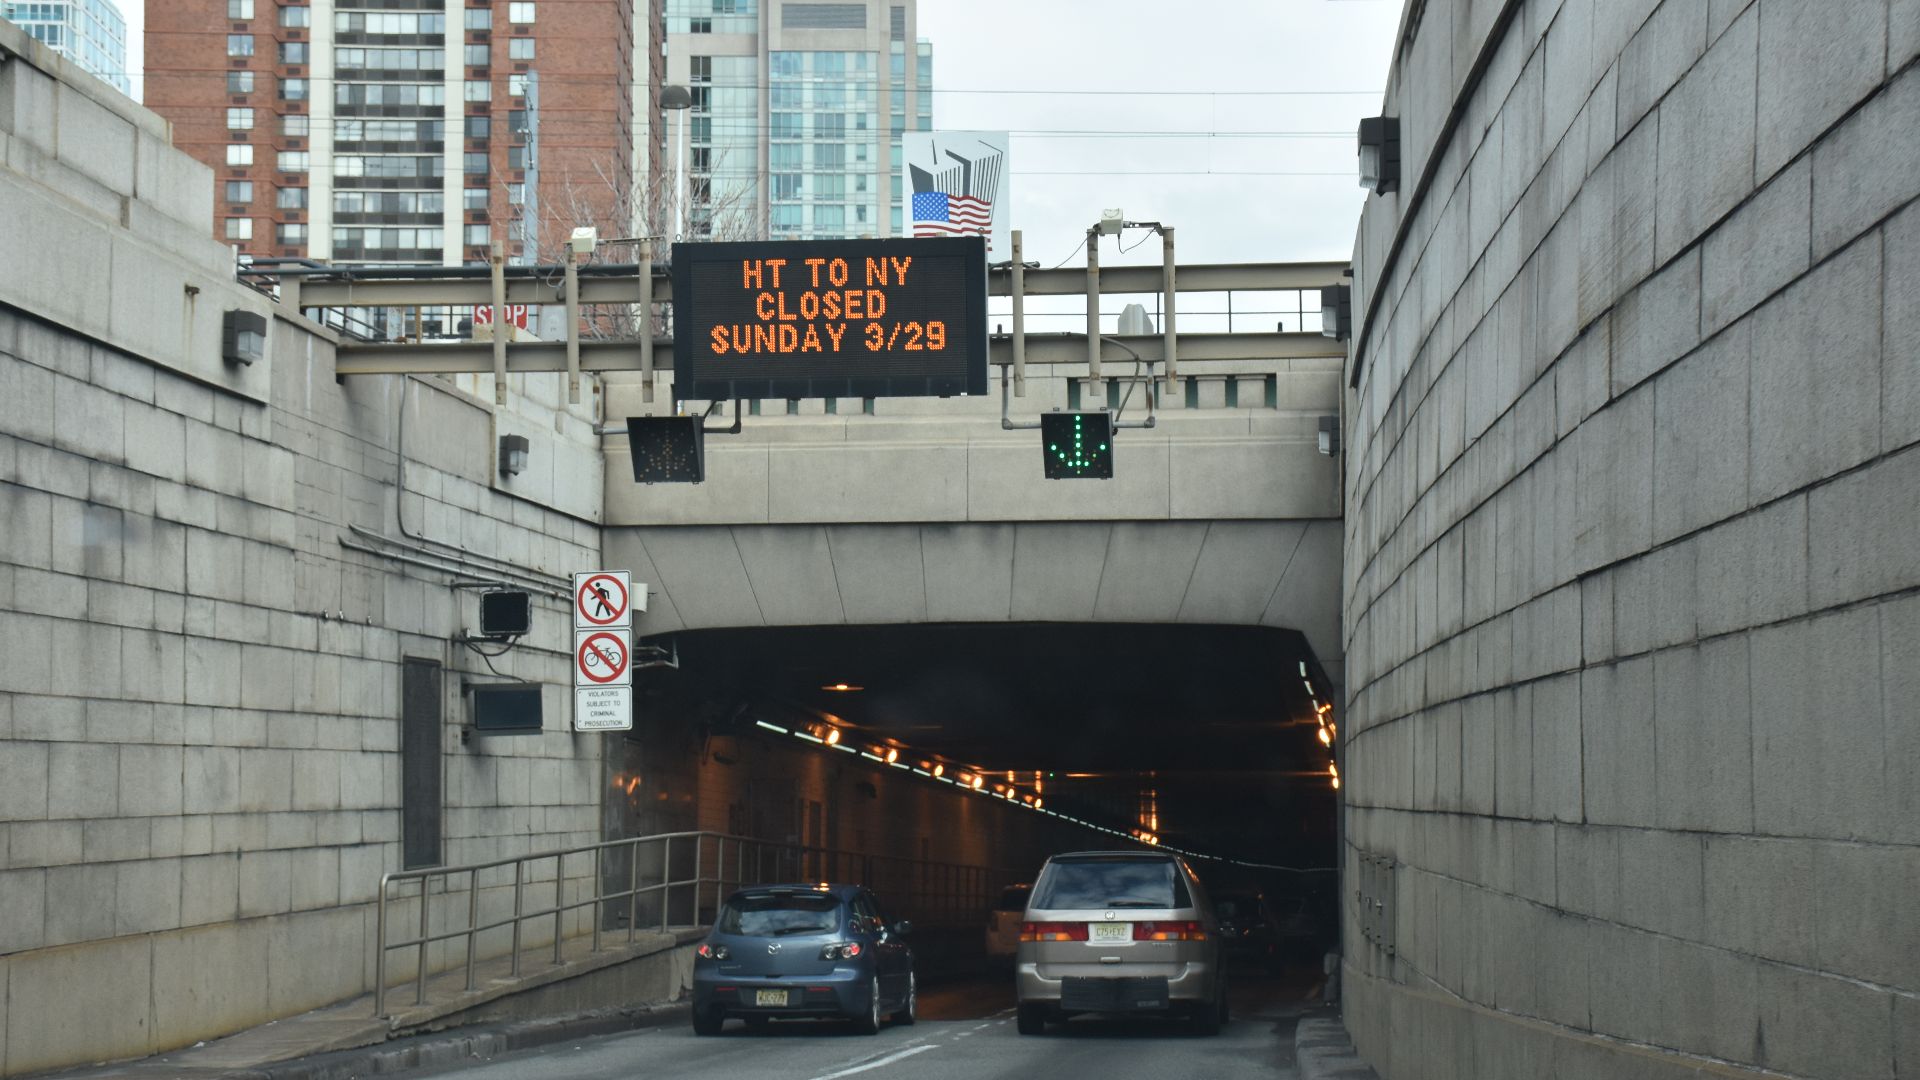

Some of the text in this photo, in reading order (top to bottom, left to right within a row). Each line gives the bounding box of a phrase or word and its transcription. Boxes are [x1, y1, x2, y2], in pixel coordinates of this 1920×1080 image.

[743, 256, 912, 289] HT TO NY
[756, 290, 886, 321] CLOSED
[710, 321, 945, 354] SUNDAY 3/29
